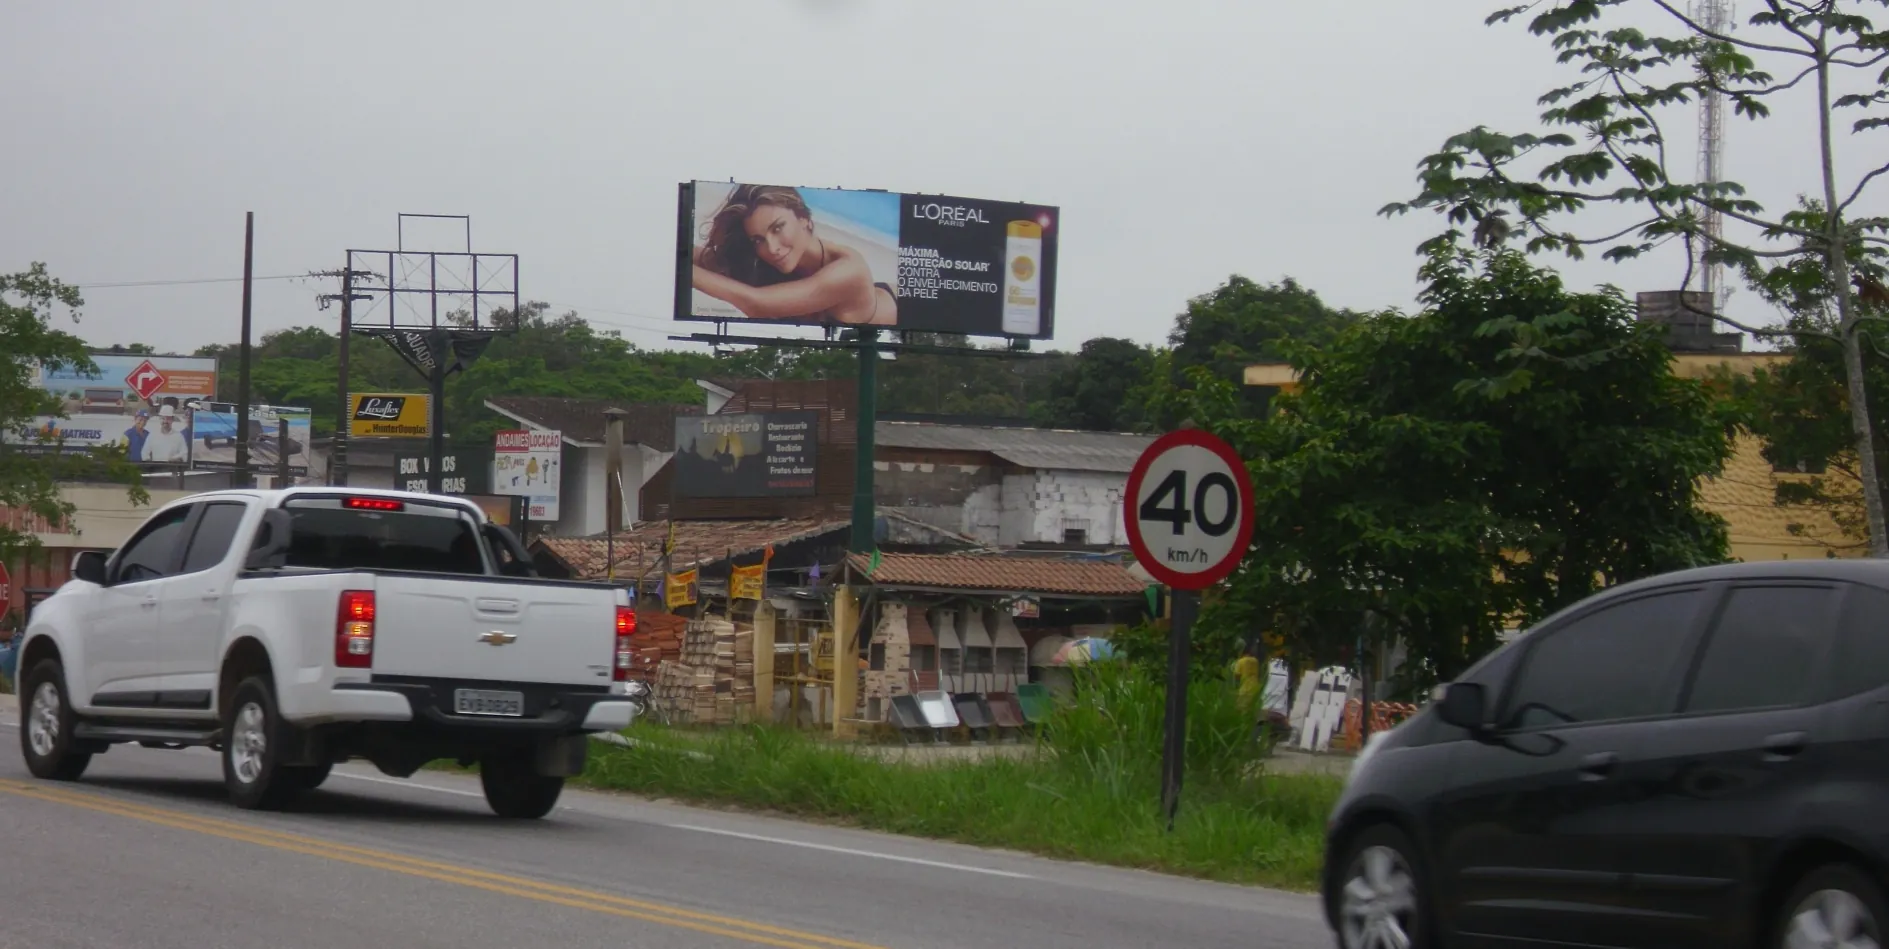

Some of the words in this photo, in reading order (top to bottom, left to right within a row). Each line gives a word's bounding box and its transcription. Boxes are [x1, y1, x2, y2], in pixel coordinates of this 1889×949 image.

[913, 203, 990, 224] L'ORÉAL
[938, 219, 965, 228] PARIS
[898, 246, 939, 258] MÁXIMA
[898, 257, 952, 269] PROTEÇÃO
[898, 267, 940, 278] CONTRA
[897, 277, 905, 287] O
[908, 278, 998, 293] ENVELHECIMENTO
[897, 288, 911, 297] DA
[913, 289, 938, 299] PELE
[357, 398, 399, 419] Luxaflex
[61, 429, 103, 439] MATHEUS
[702, 419, 760, 435] Tropeiro
[496, 433, 529, 447] ANDAIMES
[530, 432, 559, 448] LOCAÇÃO
[400, 458, 418, 474] BOX
[423, 456, 456, 473] VOS
[1139, 469, 1239, 537] 40
[1167, 547, 1208, 563] km/h
